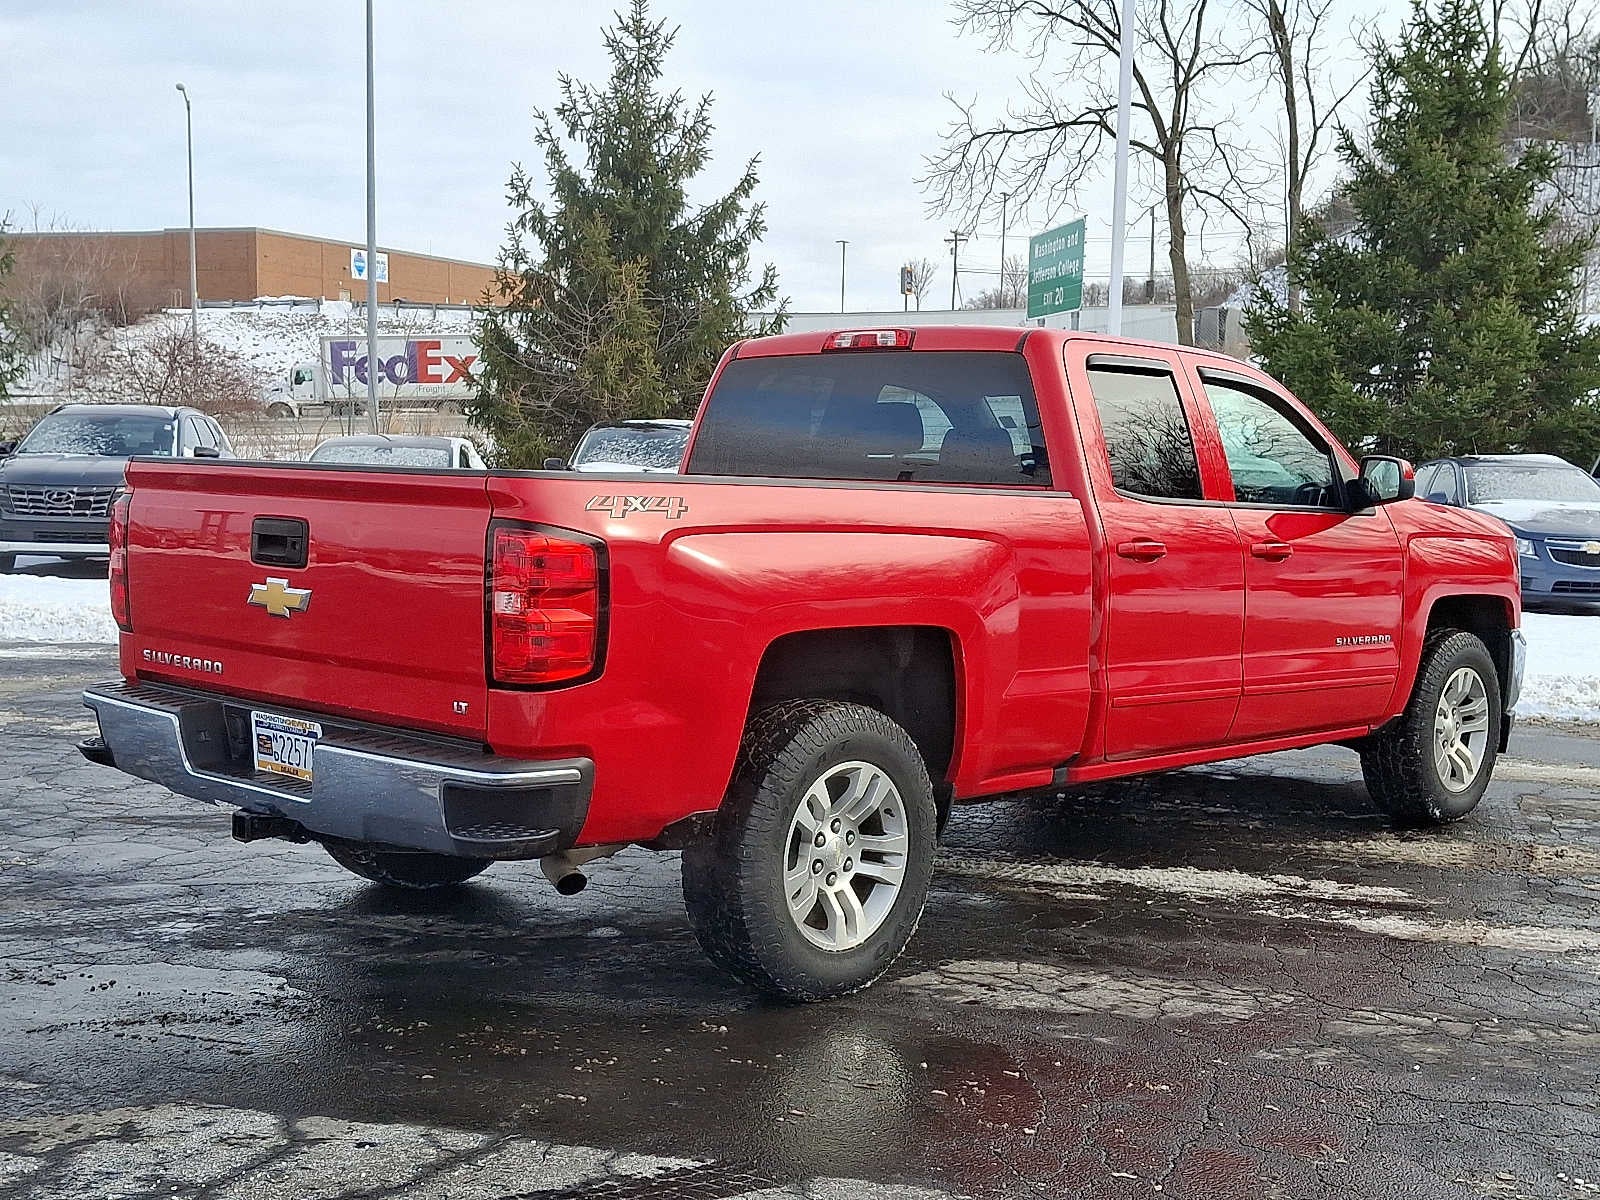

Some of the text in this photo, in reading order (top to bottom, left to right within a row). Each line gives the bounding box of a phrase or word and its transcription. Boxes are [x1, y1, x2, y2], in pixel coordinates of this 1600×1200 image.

[1034, 229, 1079, 259] Washington and
[1031, 259, 1079, 285] Jefferson College
[1055, 286, 1064, 305] 20
[330, 340, 478, 385] FedEx
[418, 385, 446, 395] Freight
[1335, 634, 1391, 647] SILVERADO
[143, 649, 222, 674] SILVERADO
[453, 701, 468, 715] LT
